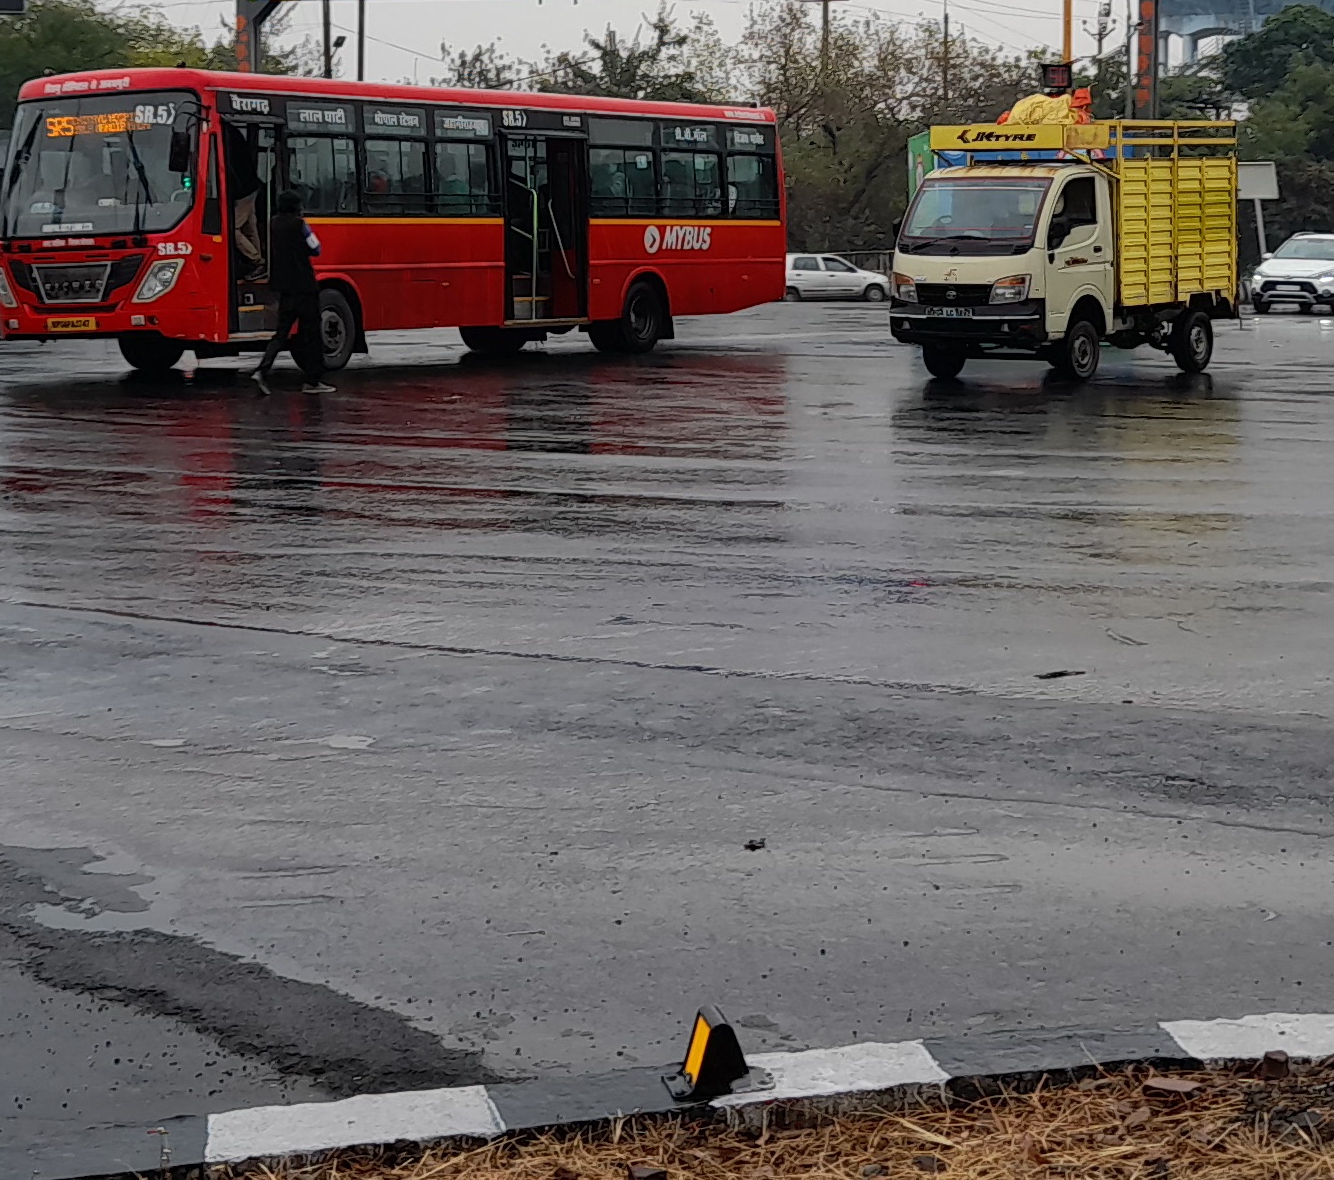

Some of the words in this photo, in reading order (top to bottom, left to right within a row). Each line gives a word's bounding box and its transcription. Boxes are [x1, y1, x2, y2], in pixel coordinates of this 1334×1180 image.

[135, 105, 169, 125] SR.5
[299, 109, 322, 123] लाल
[324, 108, 346, 124] घाटी
[46, 116, 75, 138] SR5
[662, 225, 712, 250] MYBUS
[157, 242, 187, 256] SR.5
